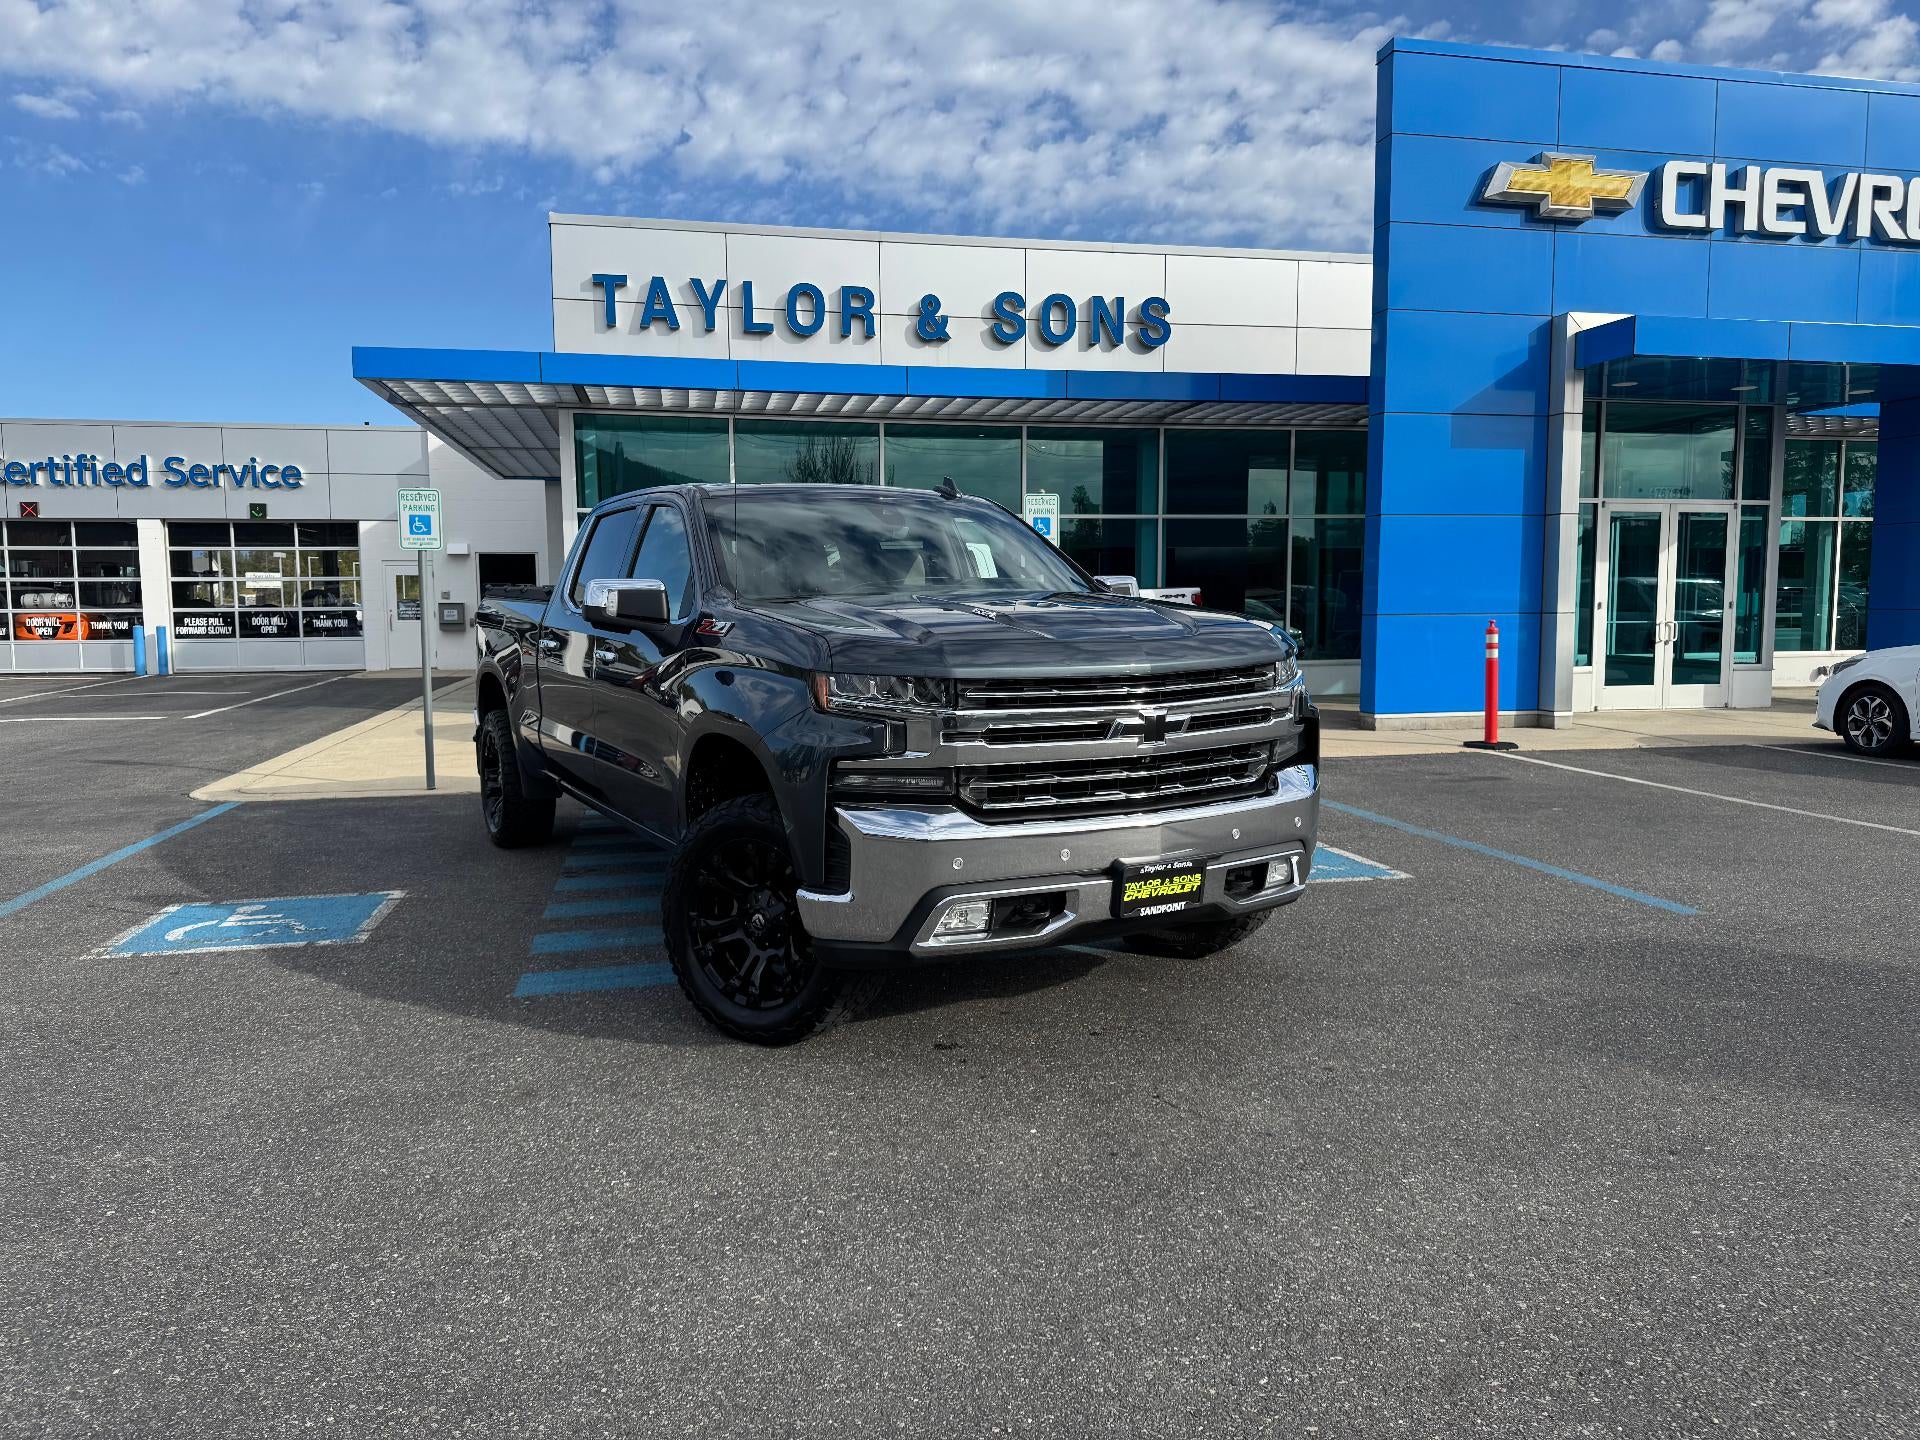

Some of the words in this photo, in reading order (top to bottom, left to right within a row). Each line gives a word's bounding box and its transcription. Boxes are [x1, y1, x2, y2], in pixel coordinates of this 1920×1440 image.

[592, 273, 876, 339] TAYLOR
[916, 293, 951, 343] &
[993, 291, 1173, 348] SONS
[0, 454, 147, 487] ertified
[164, 456, 302, 489] Service
[401, 493, 436, 501] RESERVED
[26, 617, 46, 627] DOOR
[46, 616, 62, 627] WILL
[90, 621, 113, 630] THANK
[113, 621, 129, 630] YOU!
[184, 617, 208, 626] PLEASE
[209, 617, 225, 626] PULL
[251, 616, 270, 626] DOOR
[270, 616, 285, 626] WILL
[312, 618, 333, 628] THANK
[333, 618, 348, 628] YOU!
[35, 626, 53, 636] OPEN
[176, 626, 207, 635] FORWARD
[208, 626, 233, 635] SLOWLY
[260, 626, 278, 634] OPEN
[1144, 865, 1166, 873] Taylor
[1173, 861, 1190, 869] Sons
[1124, 878, 1162, 891] TAYLOR
[1163, 878, 1171, 887] &
[1172, 873, 1202, 884] SONS
[1123, 882, 1201, 902] CHEVROLET
[1140, 902, 1186, 916] SANDPOINT
